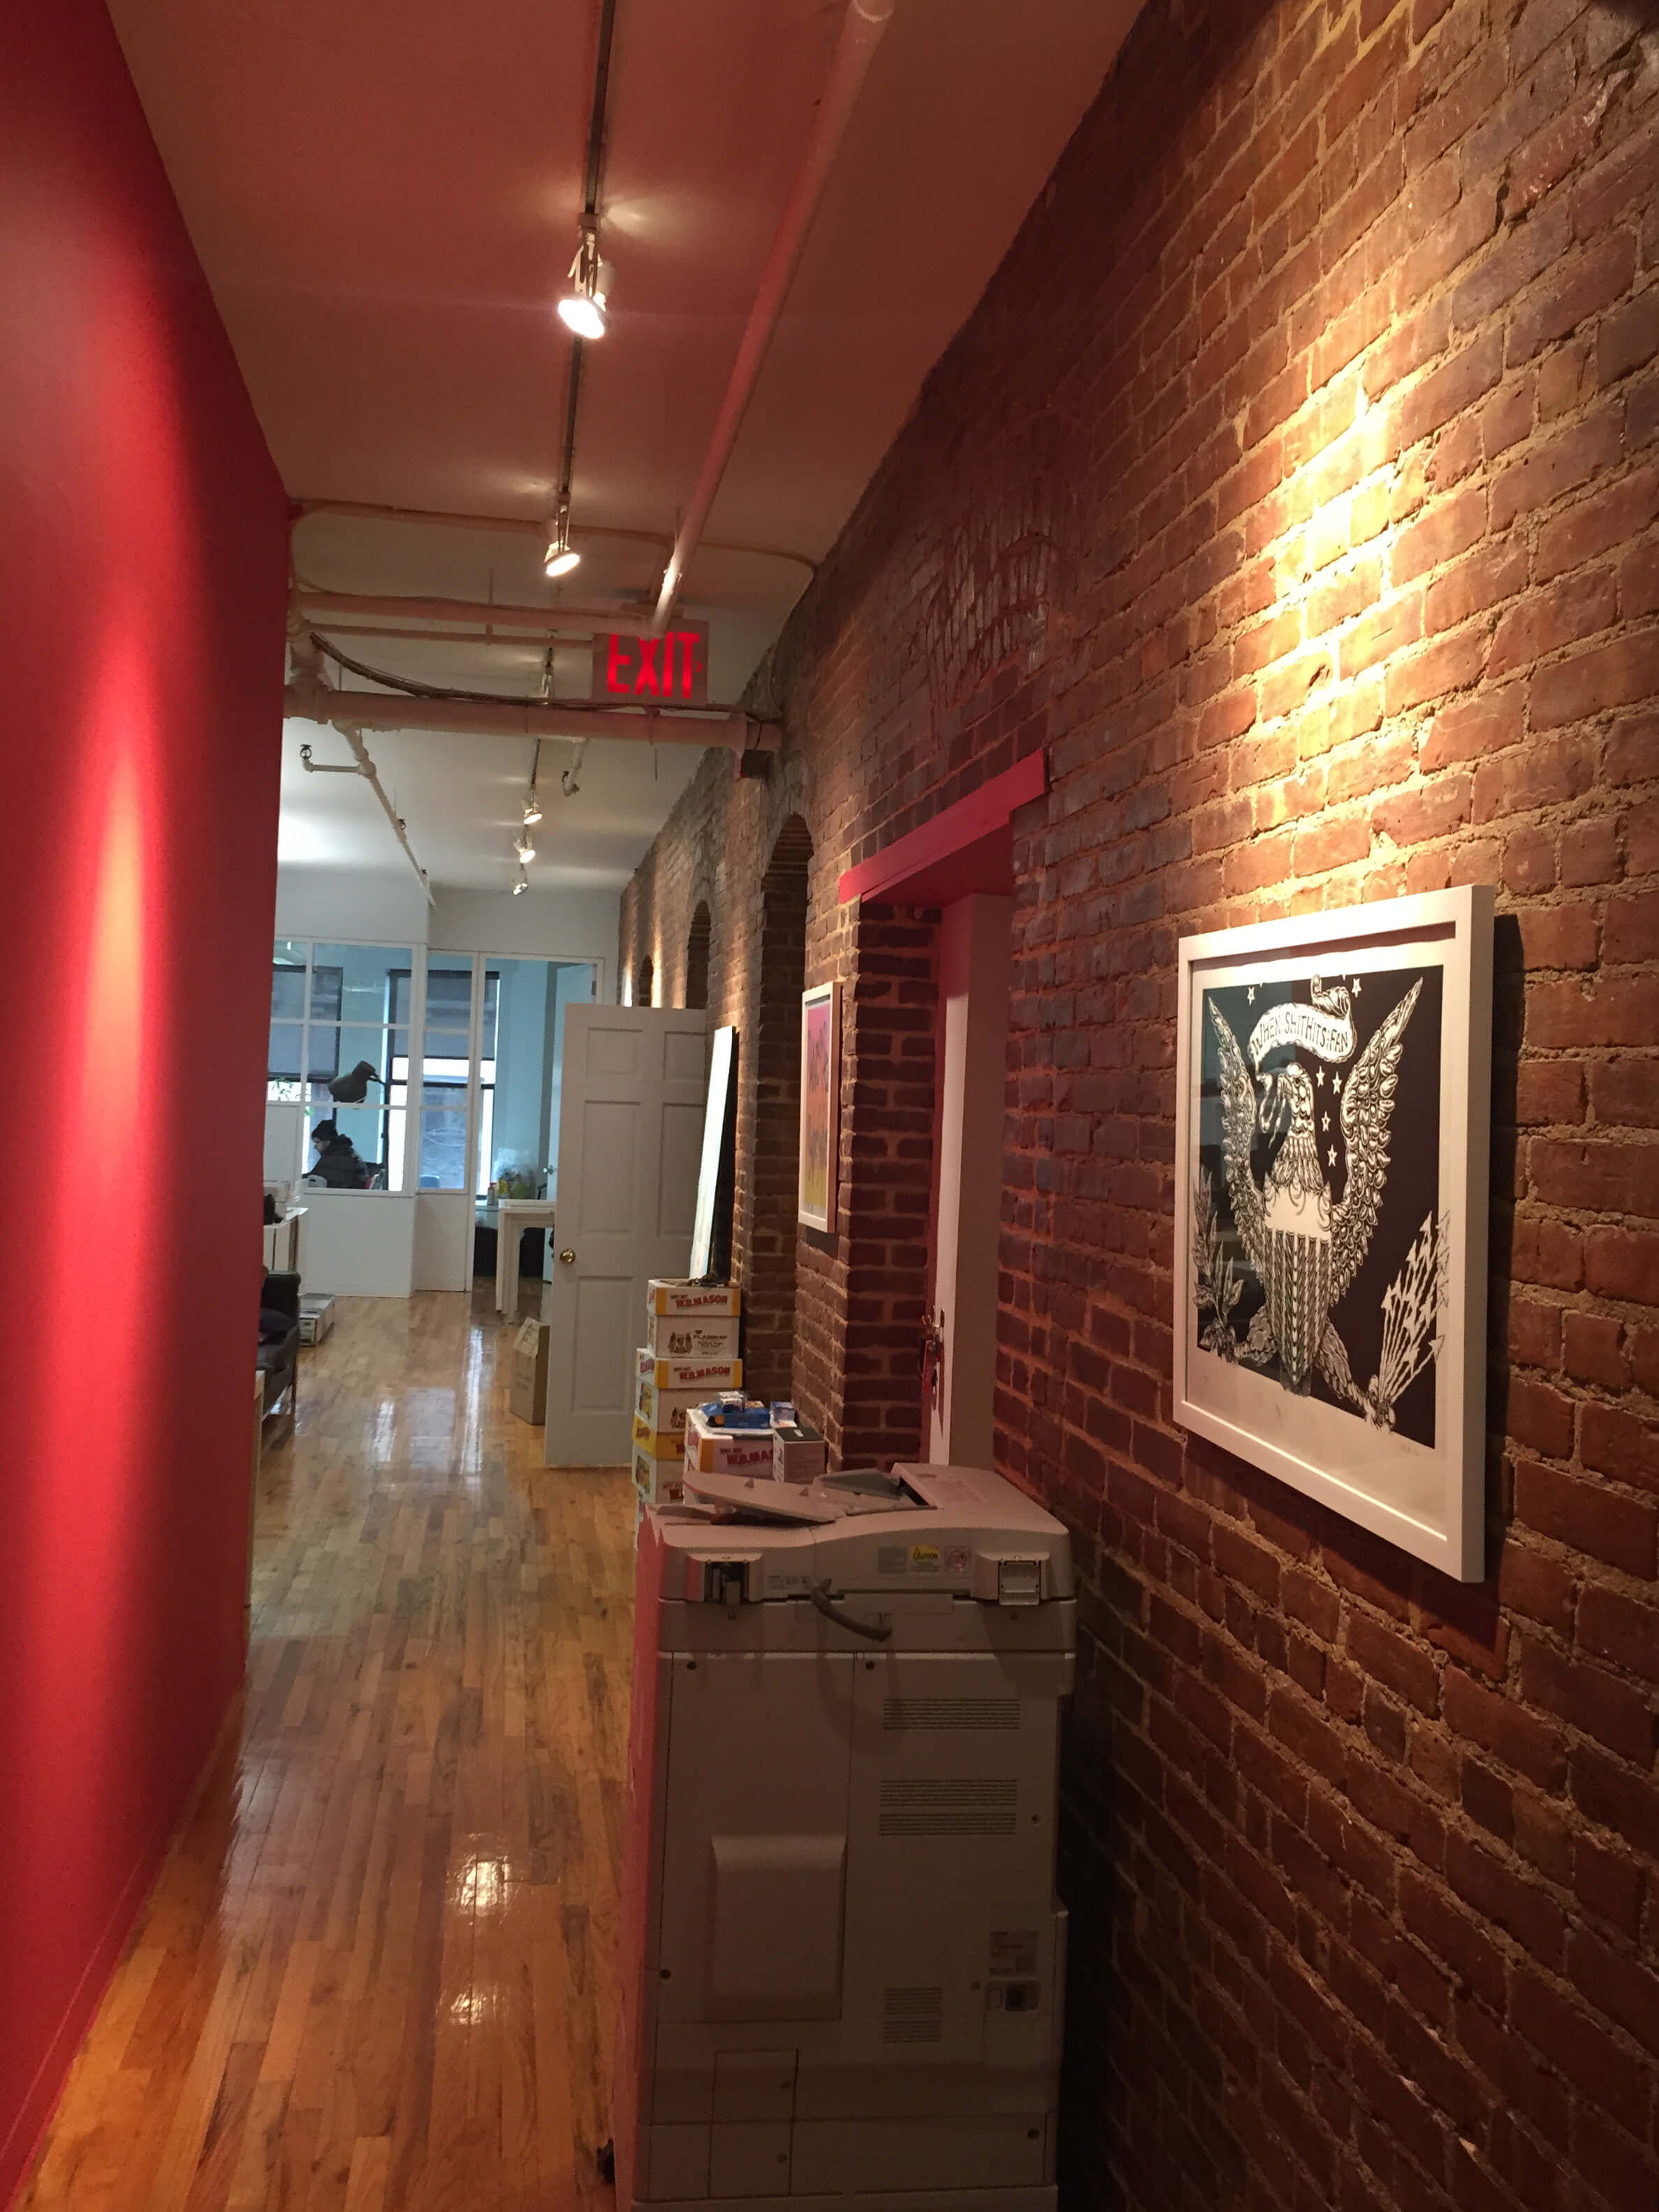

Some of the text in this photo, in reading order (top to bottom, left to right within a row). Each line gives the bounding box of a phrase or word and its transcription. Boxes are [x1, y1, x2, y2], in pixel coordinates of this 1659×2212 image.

[606, 631, 700, 699] EXIT
[1251, 1016, 1281, 1055] WHEN
[1284, 1012, 1306, 1036] SHIT
[1304, 1017, 1327, 1048] HITS
[1329, 1029, 1348, 1053] FAN
